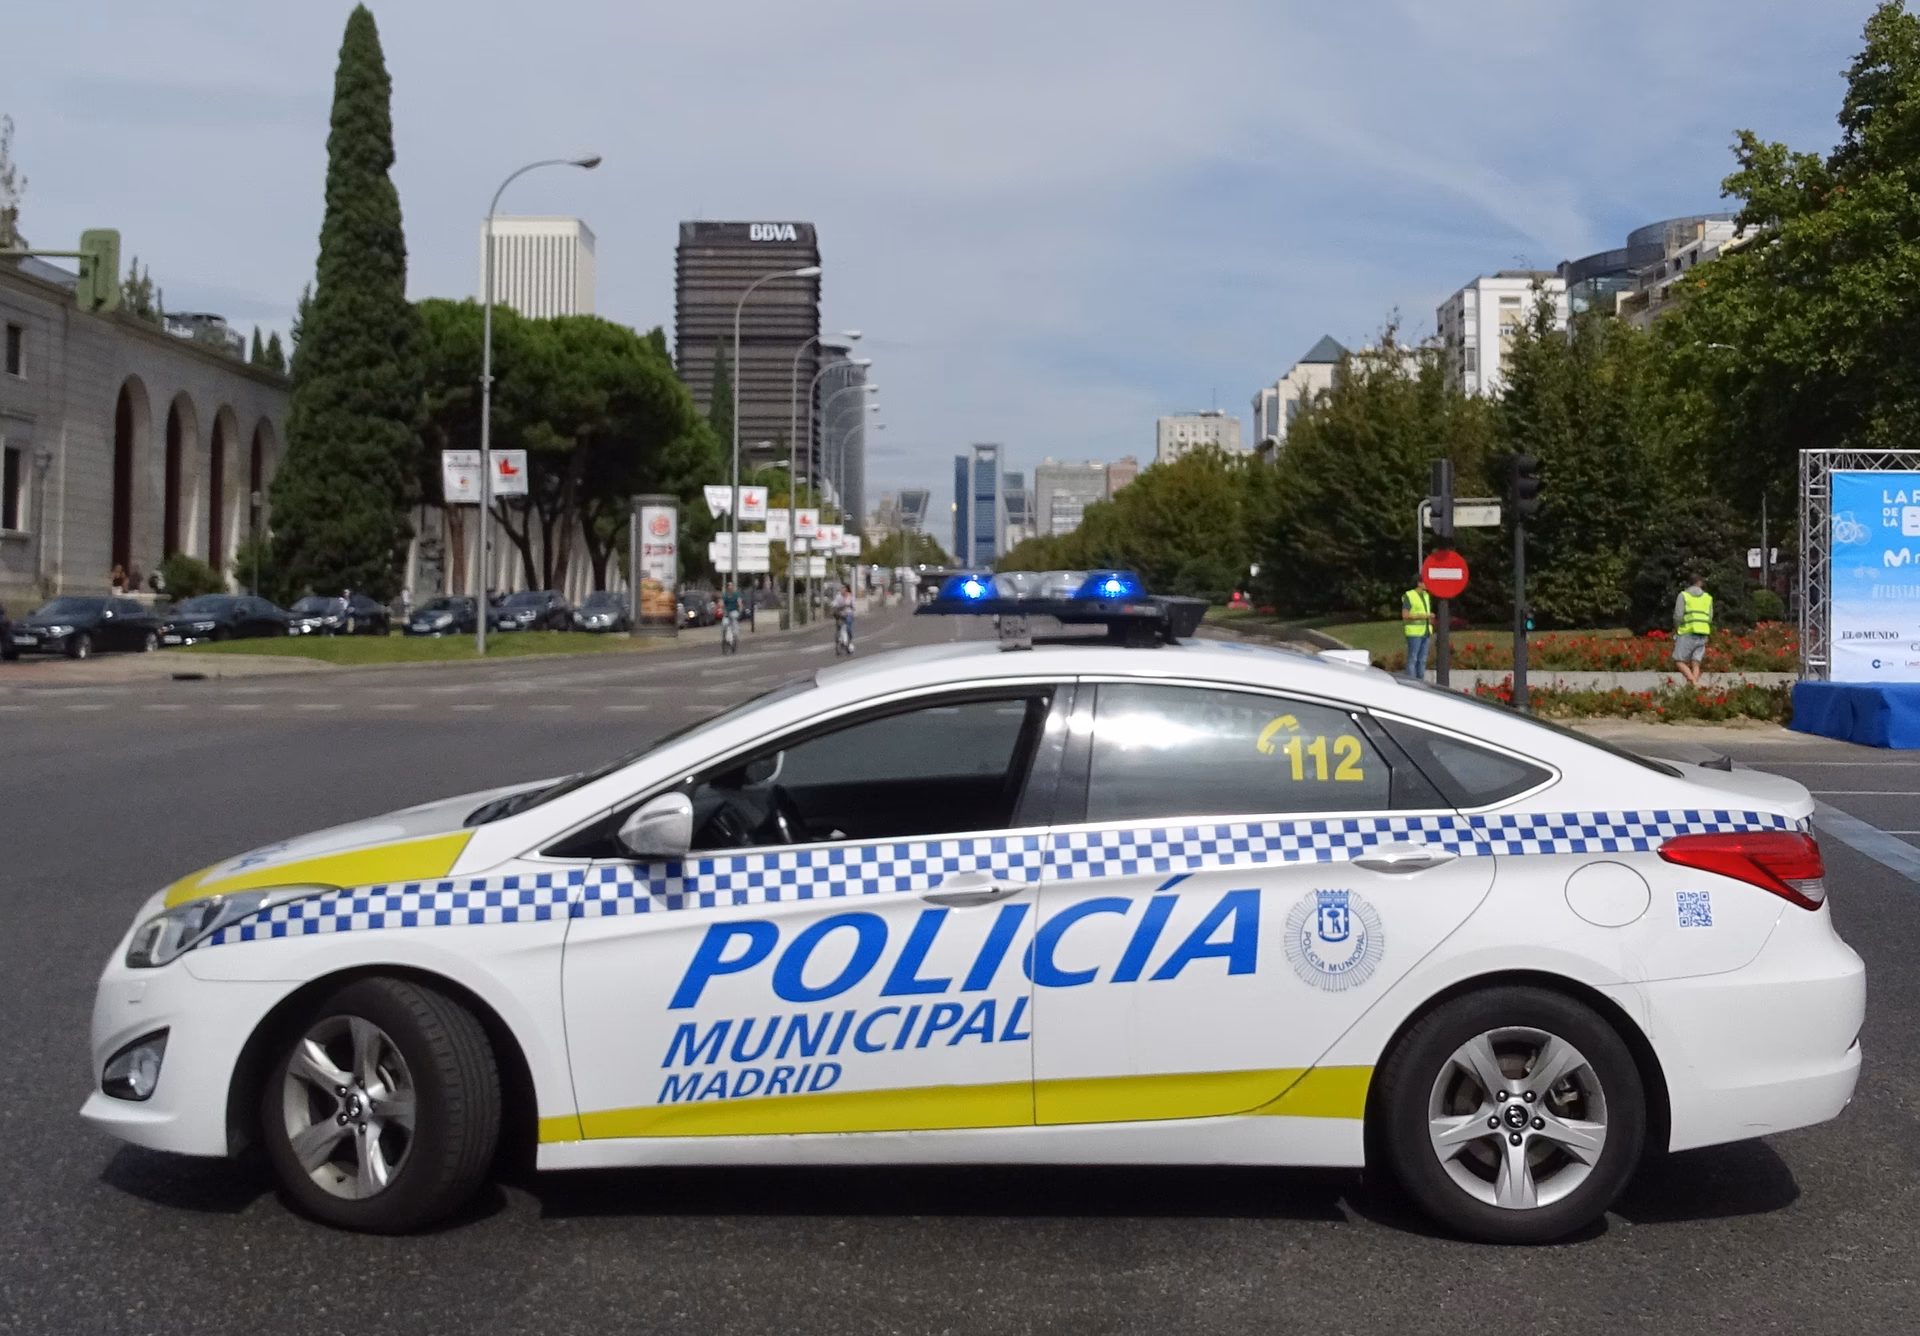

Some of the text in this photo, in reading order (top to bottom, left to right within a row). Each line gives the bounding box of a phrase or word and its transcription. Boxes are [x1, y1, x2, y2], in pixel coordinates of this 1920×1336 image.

[750, 223, 798, 241] BBVA
[1883, 489, 1908, 504] LA
[1883, 507, 1899, 517] DE
[1883, 518, 1898, 527] LA
[1842, 631, 1899, 640] EL MUNDO
[1283, 735, 1364, 781] 112
[667, 873, 1261, 1010] POLICÍA
[1328, 930, 1366, 972] MUNICIPAL
[661, 996, 1031, 1068] MUNICIPAL
[657, 1062, 842, 1104] MADRID
